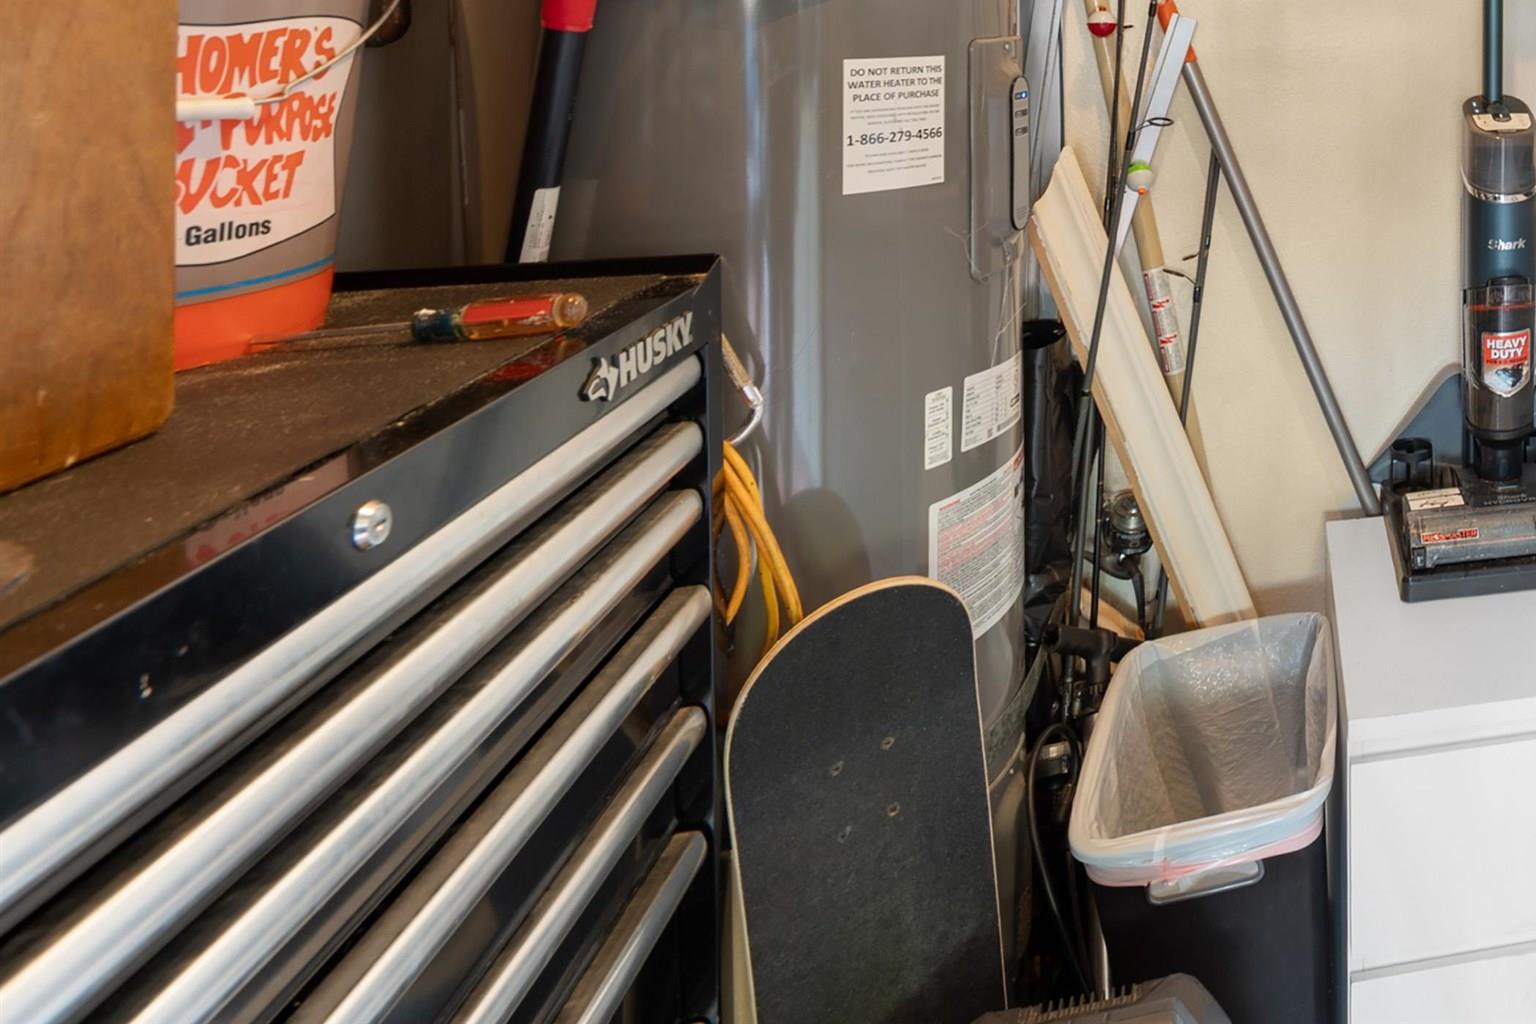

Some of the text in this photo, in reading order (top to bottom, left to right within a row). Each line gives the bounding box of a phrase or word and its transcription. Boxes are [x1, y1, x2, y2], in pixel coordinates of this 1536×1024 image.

[850, 64, 942, 77] DO NOT RETURN THIS
[847, 76, 942, 89] WATER HEATER TO THE
[852, 89, 939, 102] PLACE OF PURCHASE
[847, 127, 942, 146] 1-866-279-4566
[176, 150, 306, 215] UCKET
[185, 219, 272, 246] Gallons
[1487, 237, 1526, 251] Shark
[1486, 335, 1527, 349] HEAVY
[618, 311, 694, 388] HUSKY
[1490, 346, 1524, 359] DUTY
